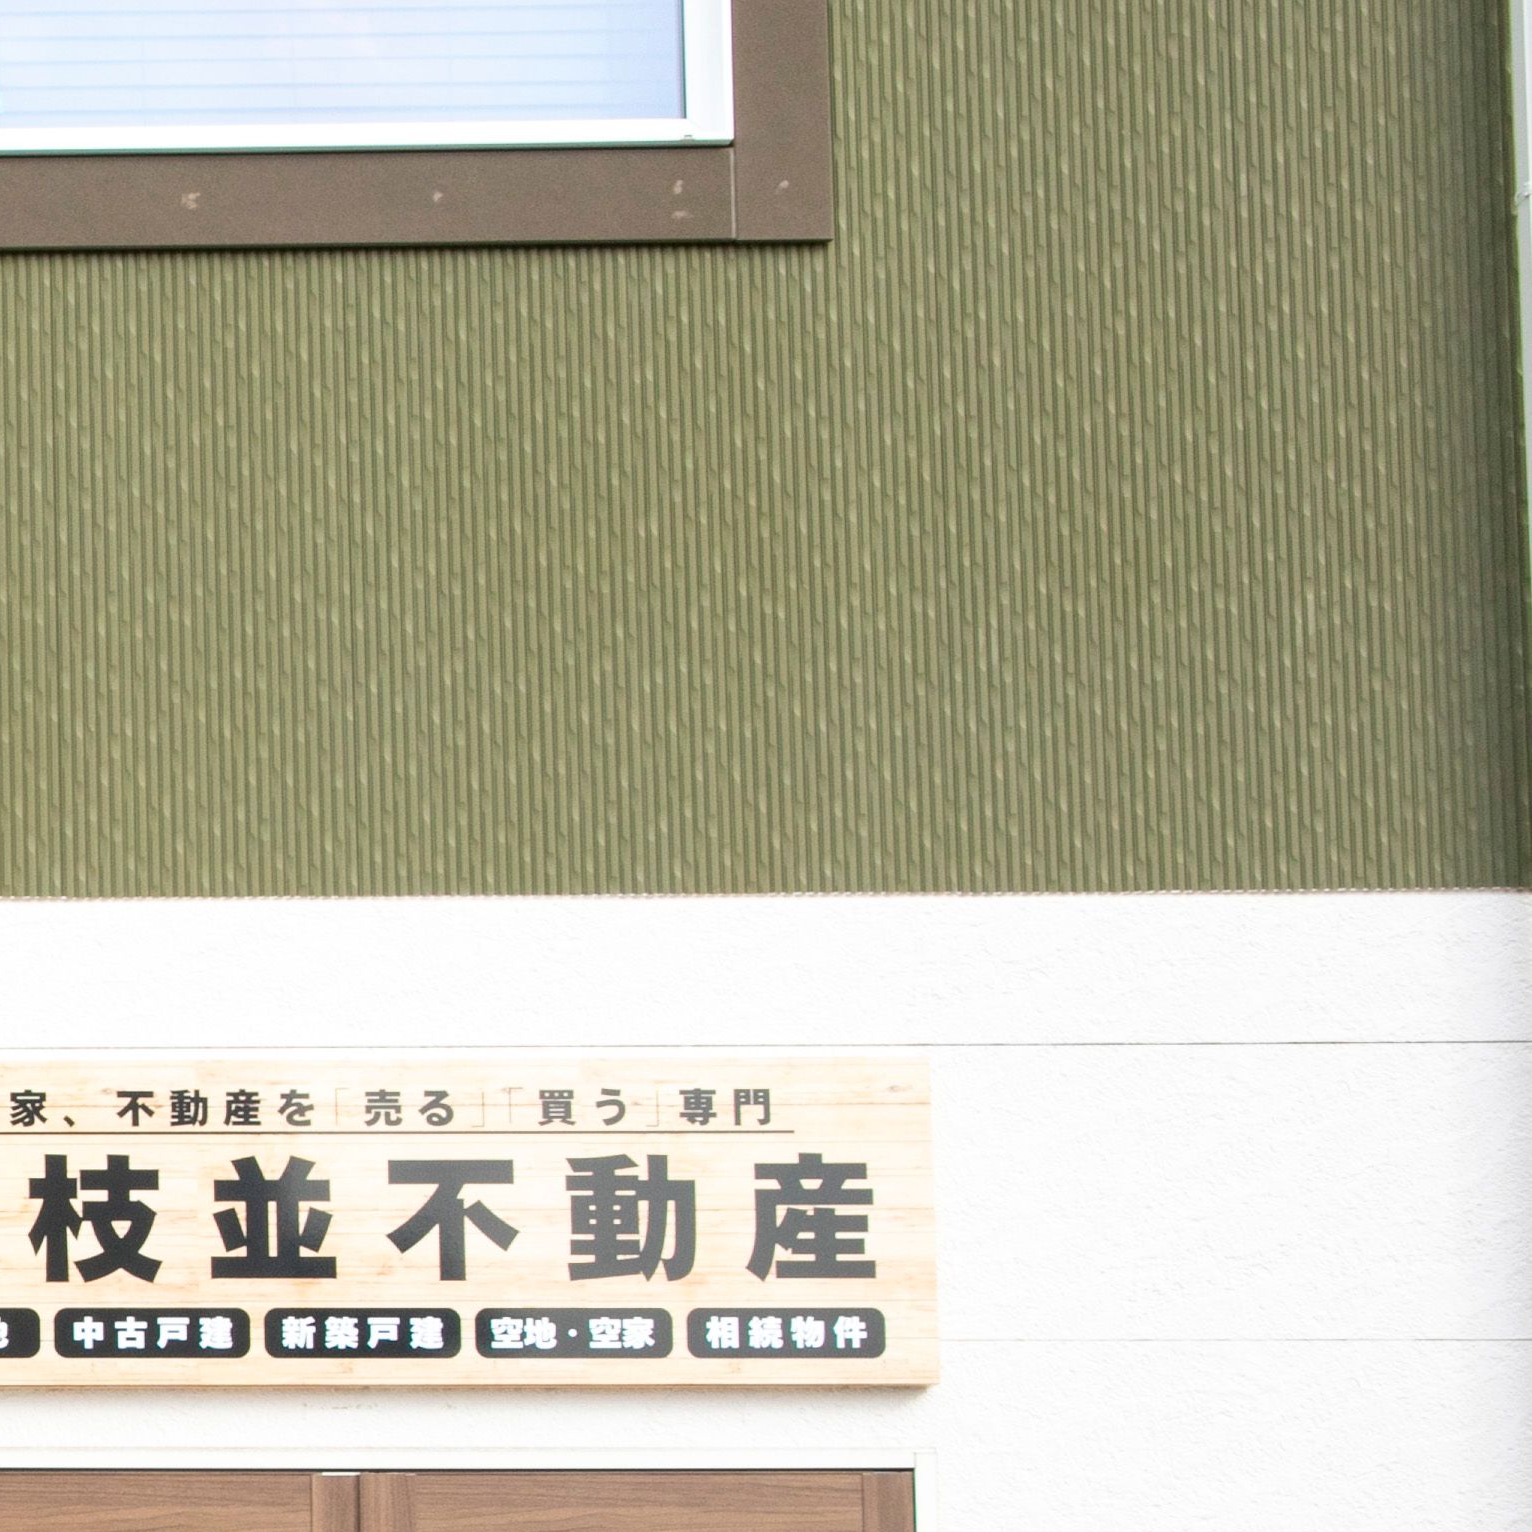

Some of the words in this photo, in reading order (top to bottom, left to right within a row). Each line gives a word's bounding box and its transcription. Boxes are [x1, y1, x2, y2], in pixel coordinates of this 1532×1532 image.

[27, 1152, 877, 1283] 枝並不動産
[72, 1316, 235, 1350] 中古戸建
[281, 1316, 445, 1350] 新築戸建
[490, 1316, 656, 1350] 空地・空家
[705, 1316, 869, 1350] 相続物件
